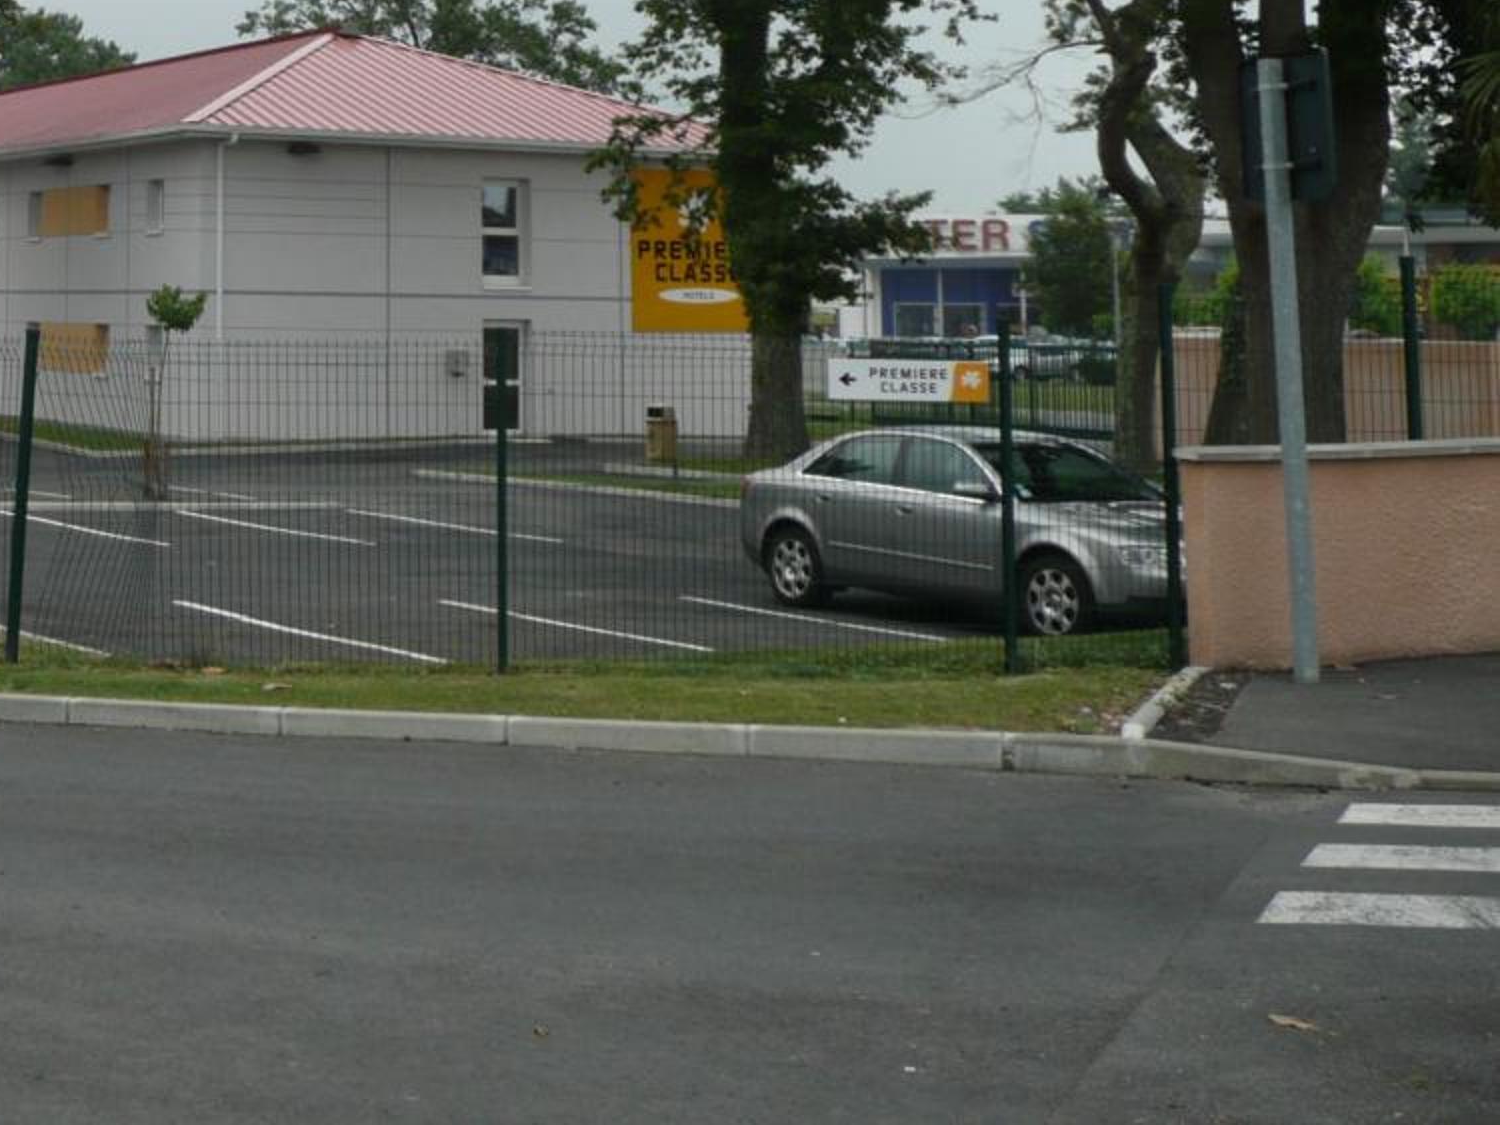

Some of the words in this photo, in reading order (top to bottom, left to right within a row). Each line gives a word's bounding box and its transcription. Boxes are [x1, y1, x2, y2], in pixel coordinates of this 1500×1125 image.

[923, 219, 1010, 251] TER
[637, 240, 726, 261] PREMIE
[869, 367, 948, 380] PREMIERE
[880, 382, 938, 394] CLASSE
